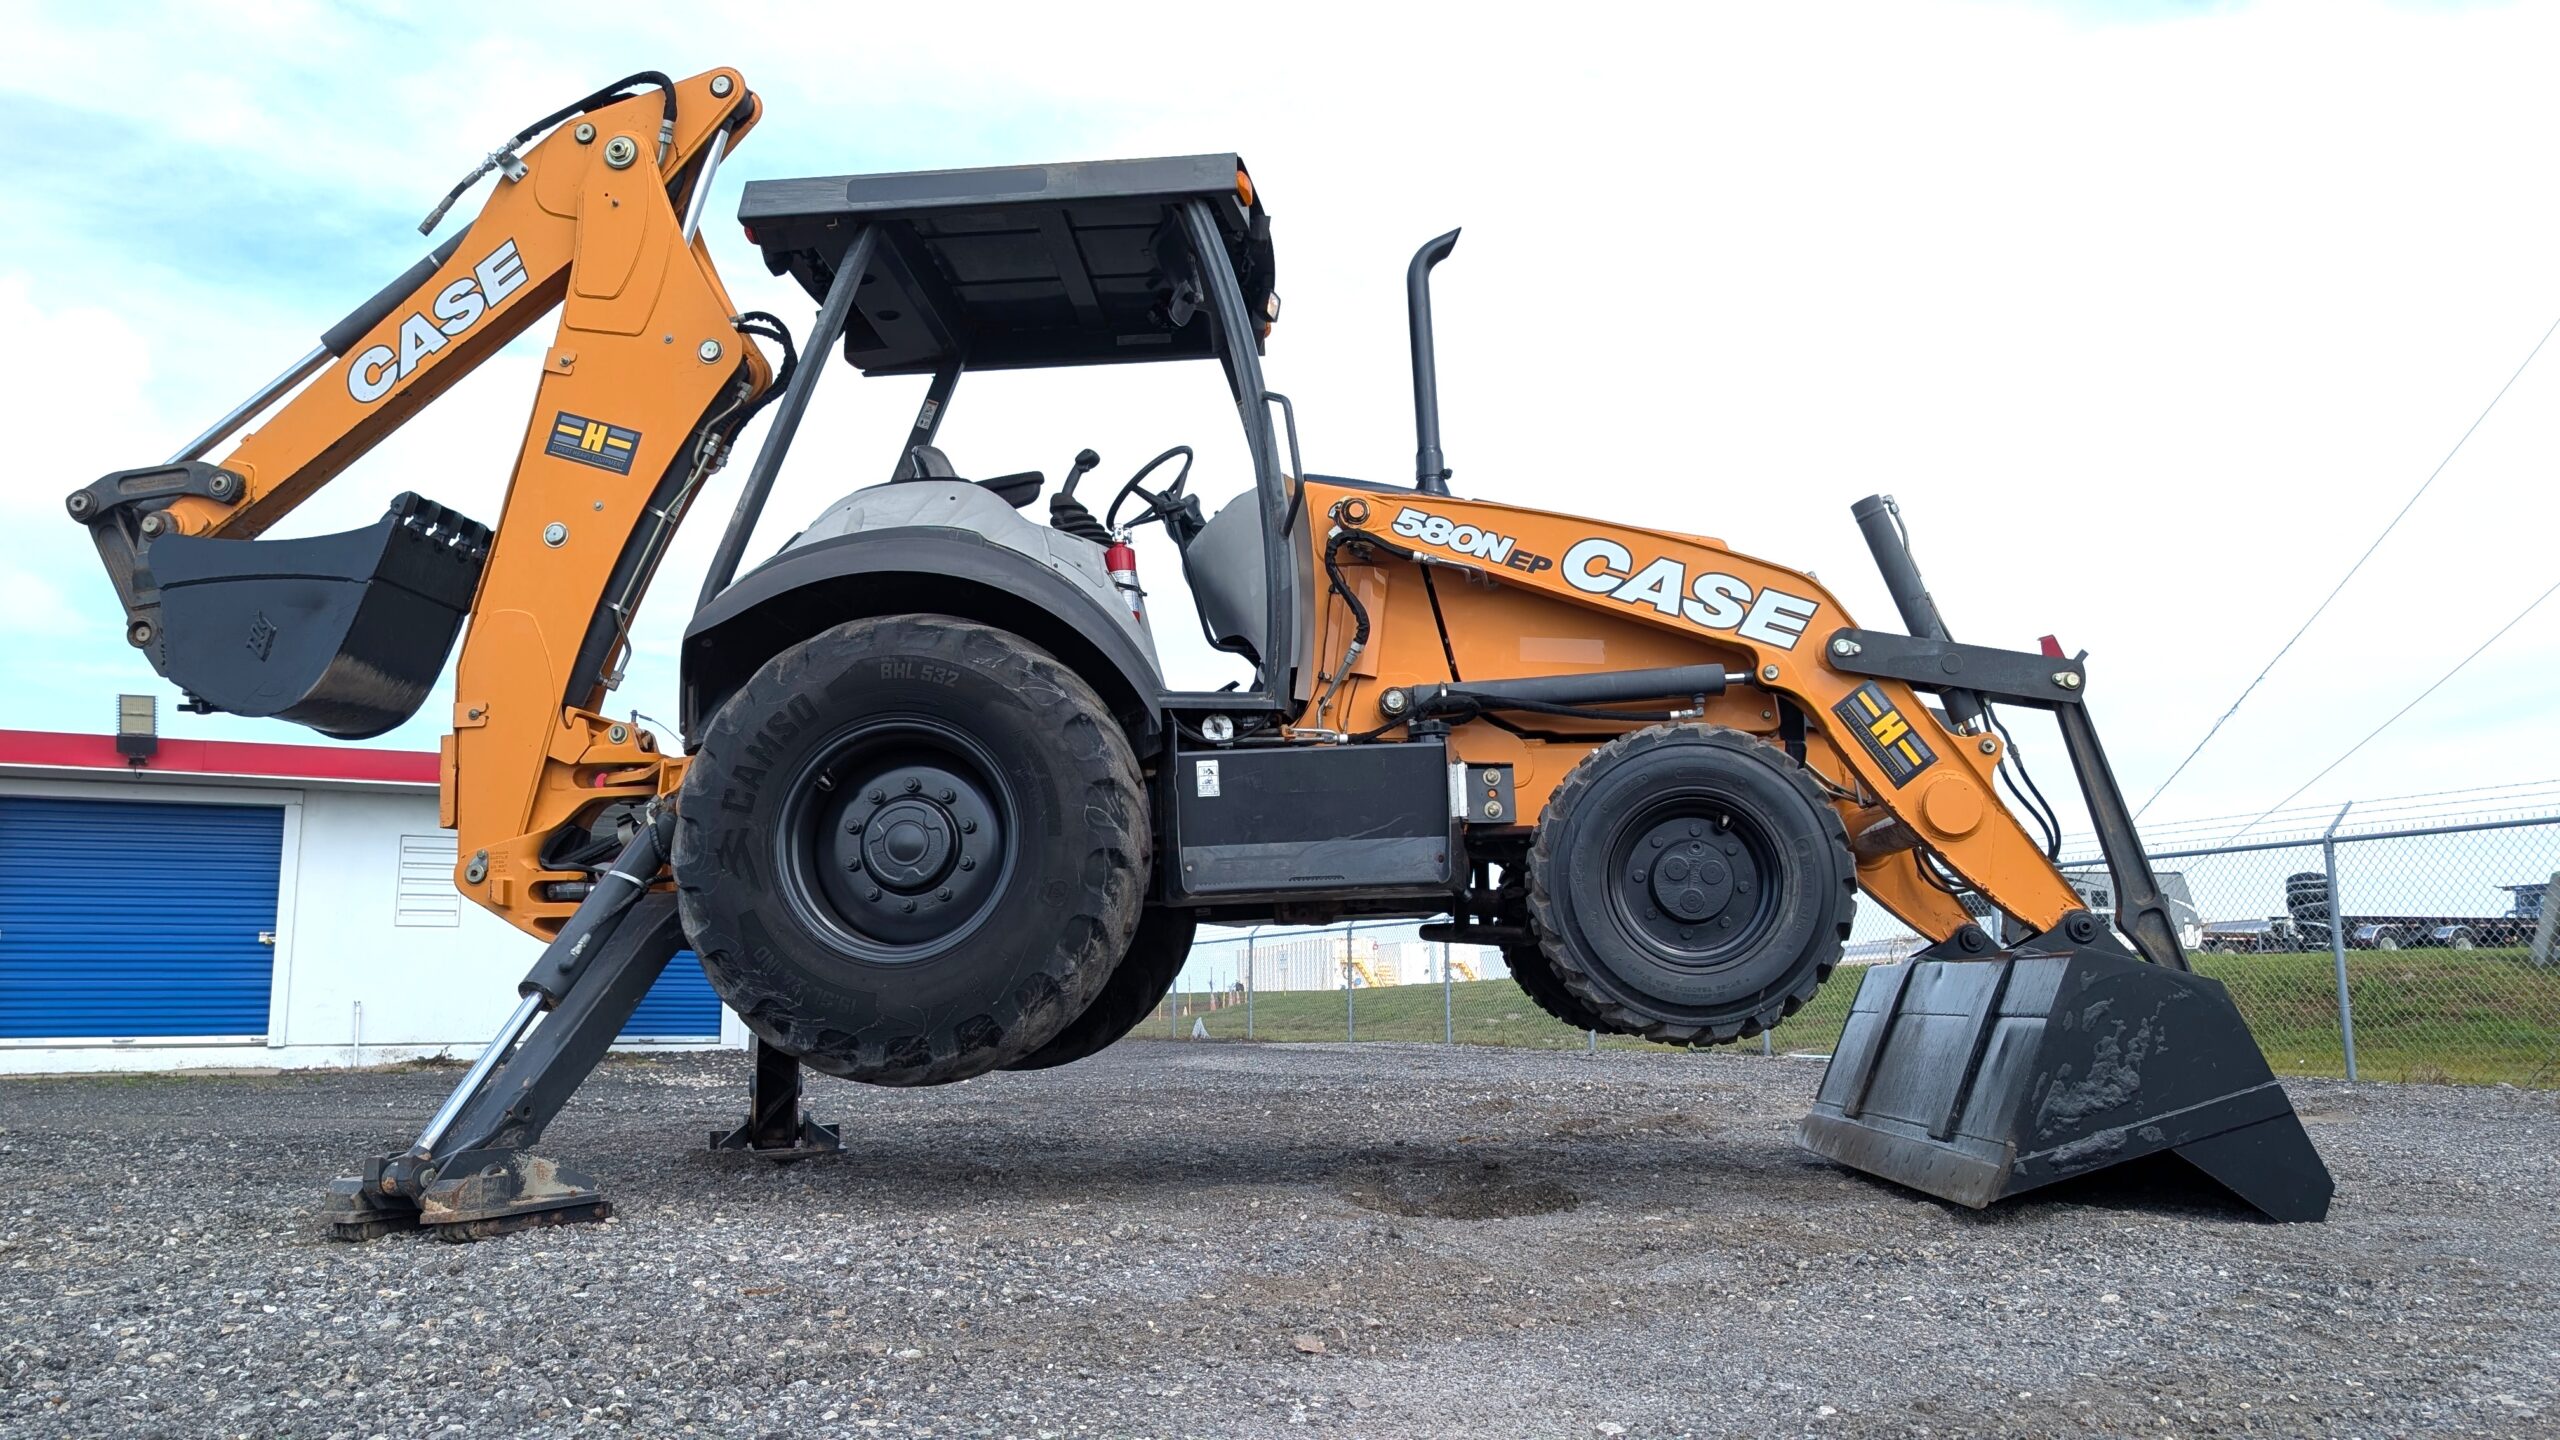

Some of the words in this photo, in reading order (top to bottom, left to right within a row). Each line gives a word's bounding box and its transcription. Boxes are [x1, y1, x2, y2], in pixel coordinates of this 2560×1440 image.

[347, 237, 529, 403] CASE
[1391, 506, 1517, 564] 580N
[1505, 549, 1553, 574] EP
[1561, 537, 1820, 652] CASE
[880, 663, 916, 681] BHL
[920, 664, 960, 688] 532
[721, 692, 820, 814] CAMSO
[1839, 705, 1861, 729] EXPERT
[1856, 726, 1877, 748] HEAVY
[1871, 744, 1903, 779] EQUIPMENT
